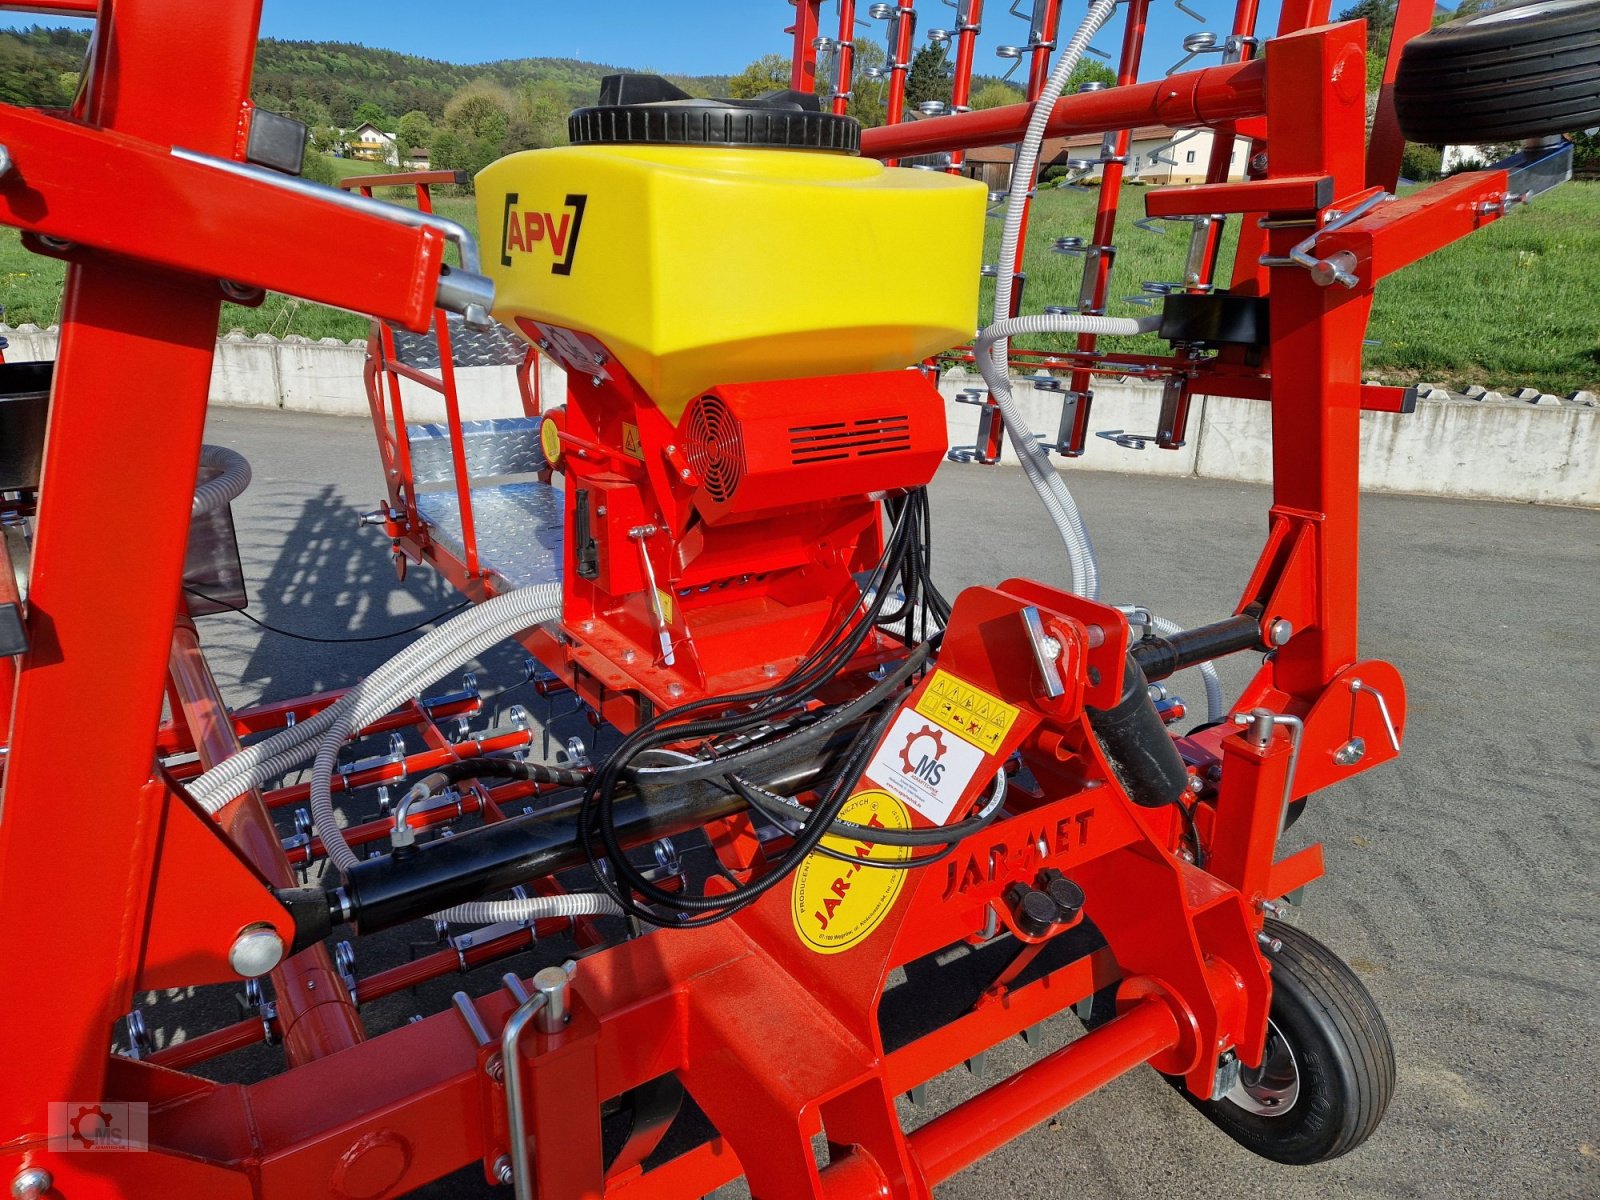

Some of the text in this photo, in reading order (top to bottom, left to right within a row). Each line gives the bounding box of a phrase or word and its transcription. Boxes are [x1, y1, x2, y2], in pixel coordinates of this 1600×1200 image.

[914, 754, 946, 786] MS
[800, 861, 810, 914] PRODUCENT
[814, 813, 885, 931] JAR-MT
[942, 808, 1115, 903] JAR-MET
